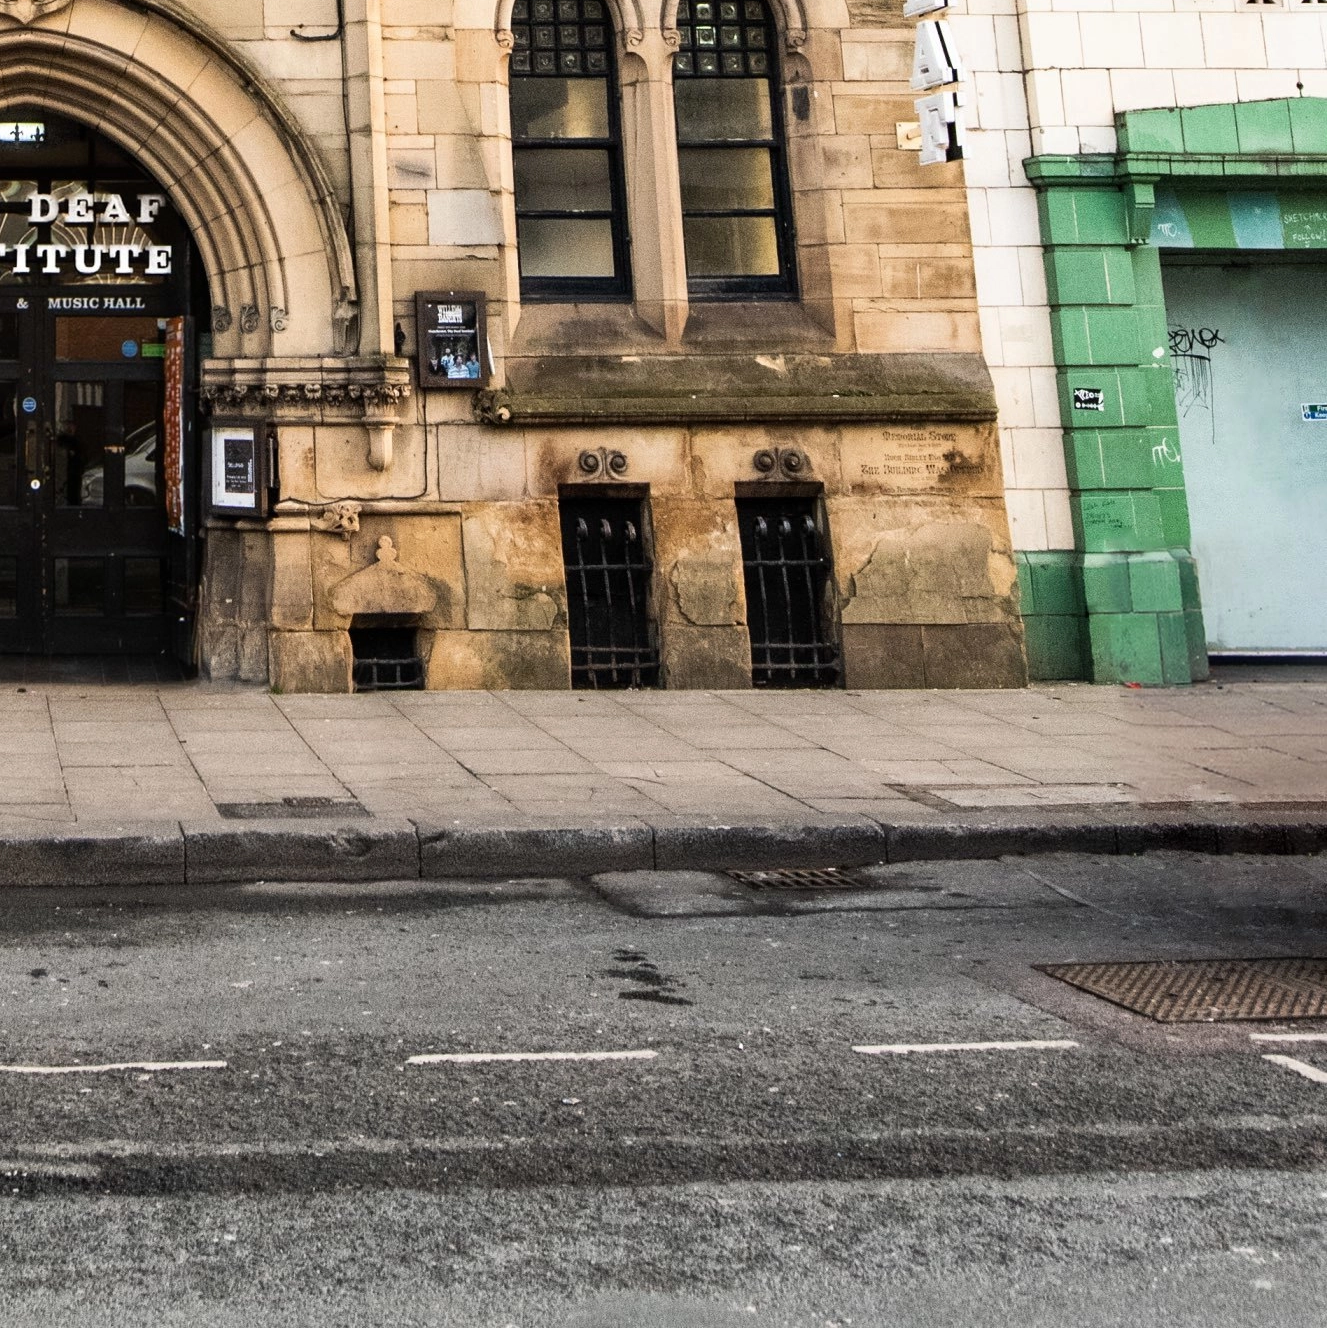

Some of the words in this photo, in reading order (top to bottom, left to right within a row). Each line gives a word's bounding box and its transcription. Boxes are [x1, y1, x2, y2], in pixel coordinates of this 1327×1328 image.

[25, 195, 167, 224] DEAF
[16, 297, 29, 309] &
[47, 297, 99, 309] MUSIC
[103, 297, 145, 309] HALL
